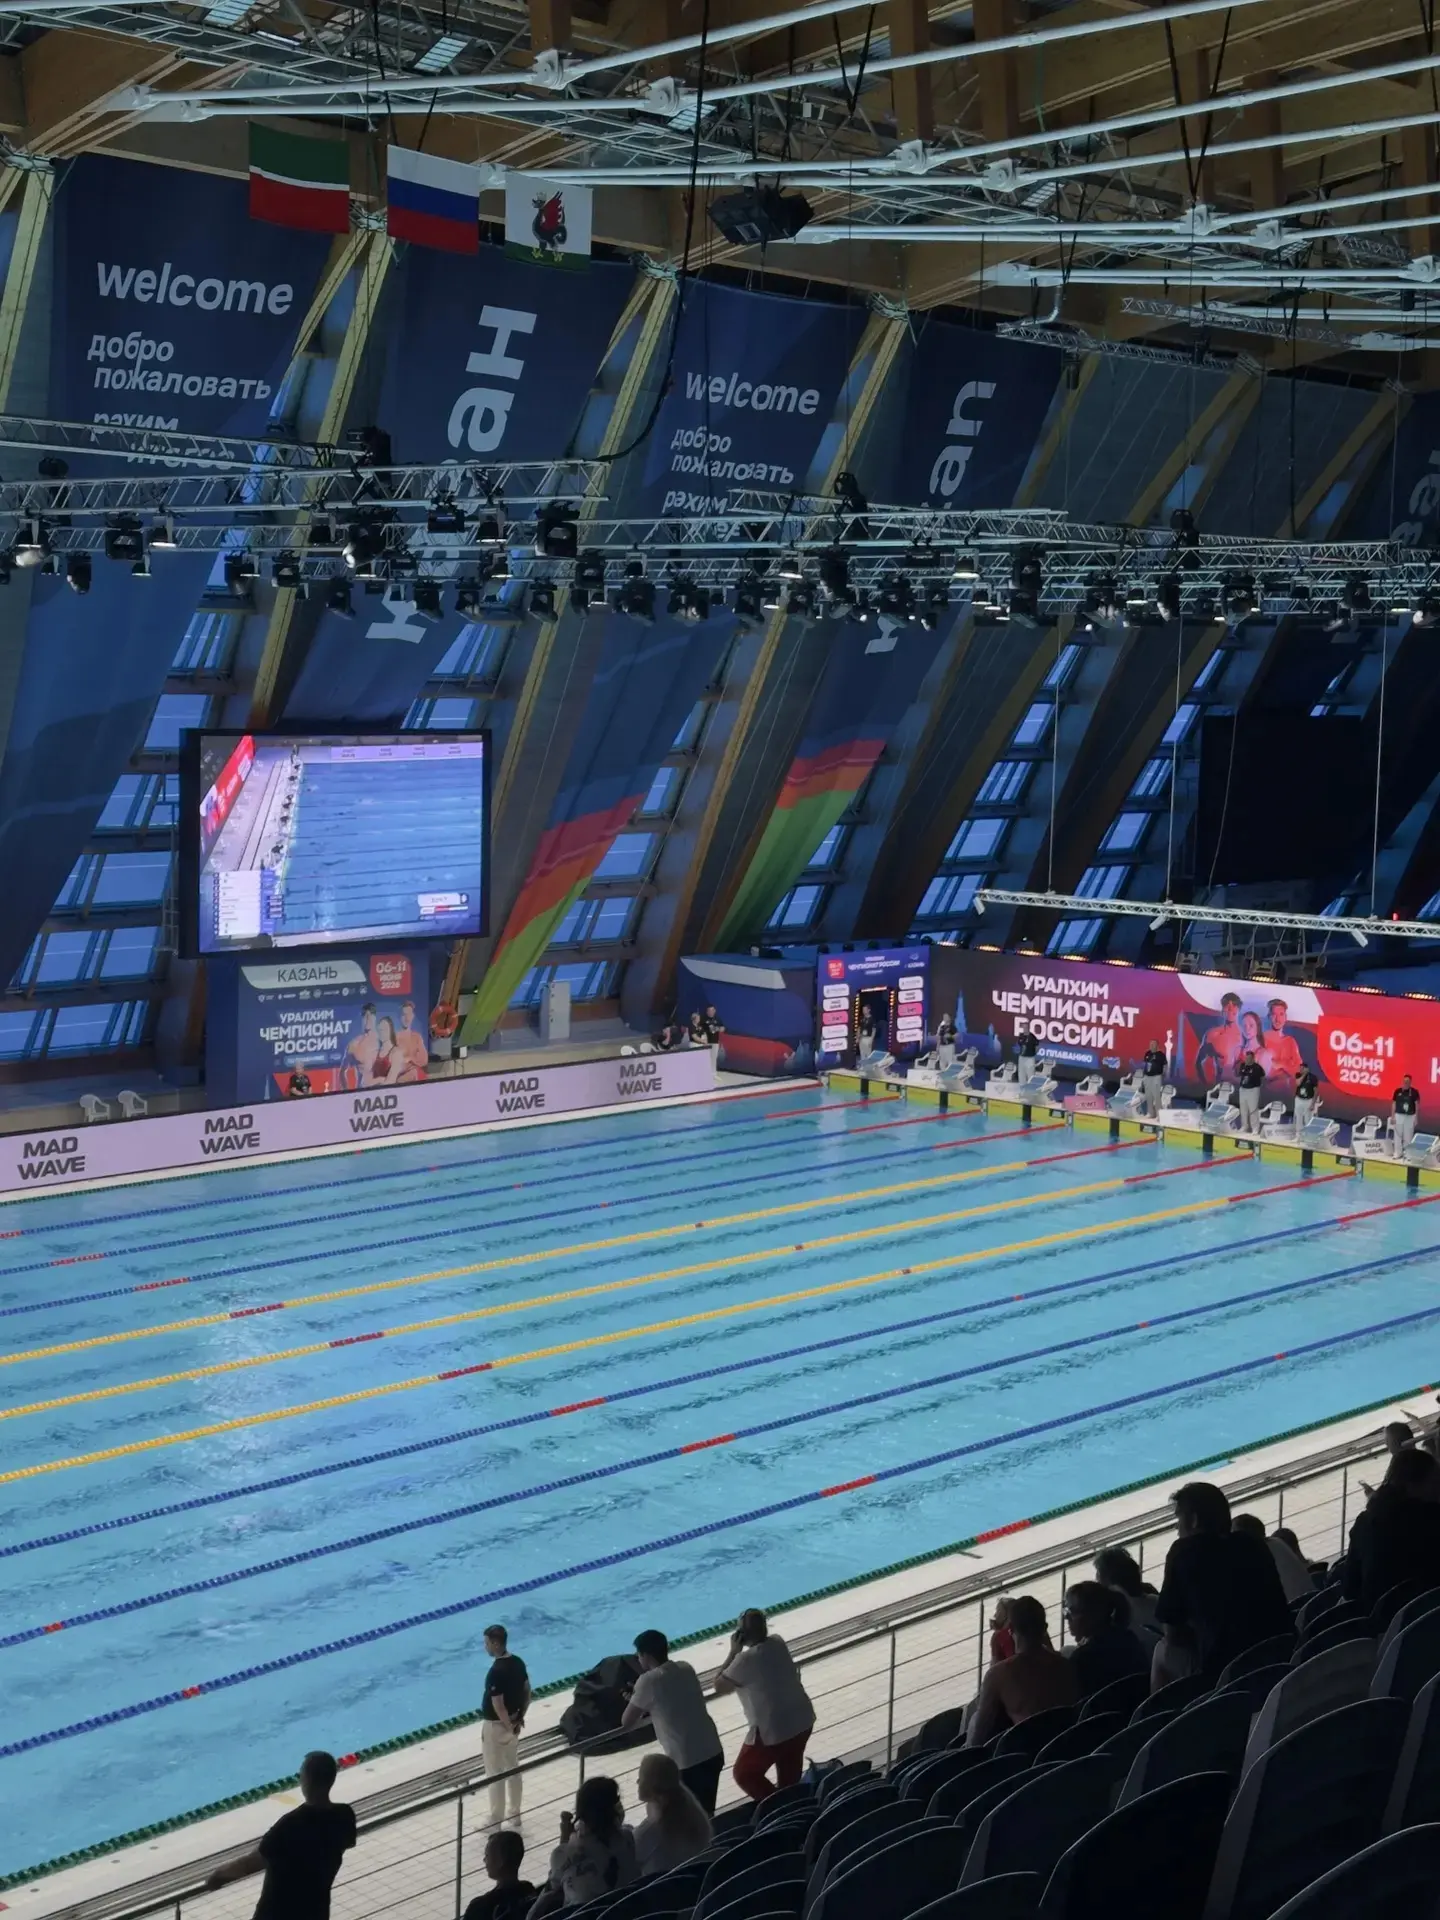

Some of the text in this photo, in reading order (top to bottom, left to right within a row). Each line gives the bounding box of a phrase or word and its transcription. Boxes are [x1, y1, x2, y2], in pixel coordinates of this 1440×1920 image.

[97, 262, 293, 315] welcome
[87, 331, 174, 372] добро
[94, 367, 271, 400] пожаловать
[685, 372, 820, 415] welcome
[670, 426, 732, 457] добро
[277, 966, 338, 983] КАЗАНЬ
[376, 961, 407, 973] 06-11
[1021, 974, 1109, 999] УРАЛХИМ
[280, 1009, 334, 1023] УРАЛХИМ
[992, 990, 1139, 1028] ЧЕМПИОНАТ
[259, 1020, 352, 1041] ЧЕМПИОНАТ
[1014, 1017, 1114, 1049] РОССИИ
[274, 1036, 337, 1055] РОССИИ
[1329, 1029, 1394, 1058] 06-11
[1046, 1048, 1093, 1063] ПЛАВАНИЮ
[1337, 1053, 1384, 1072] ИЮНЯ
[619, 1061, 657, 1078] MAD
[1339, 1069, 1381, 1087] 2026
[499, 1077, 539, 1095] MAD
[616, 1078, 662, 1096] WAVE
[353, 1095, 398, 1113] MAD
[495, 1094, 545, 1113] WAVE
[204, 1113, 254, 1134] MAD
[349, 1112, 404, 1133] WAVE
[23, 1136, 78, 1158] MAD
[199, 1132, 260, 1155] WAVE
[17, 1155, 85, 1180] WAVE
